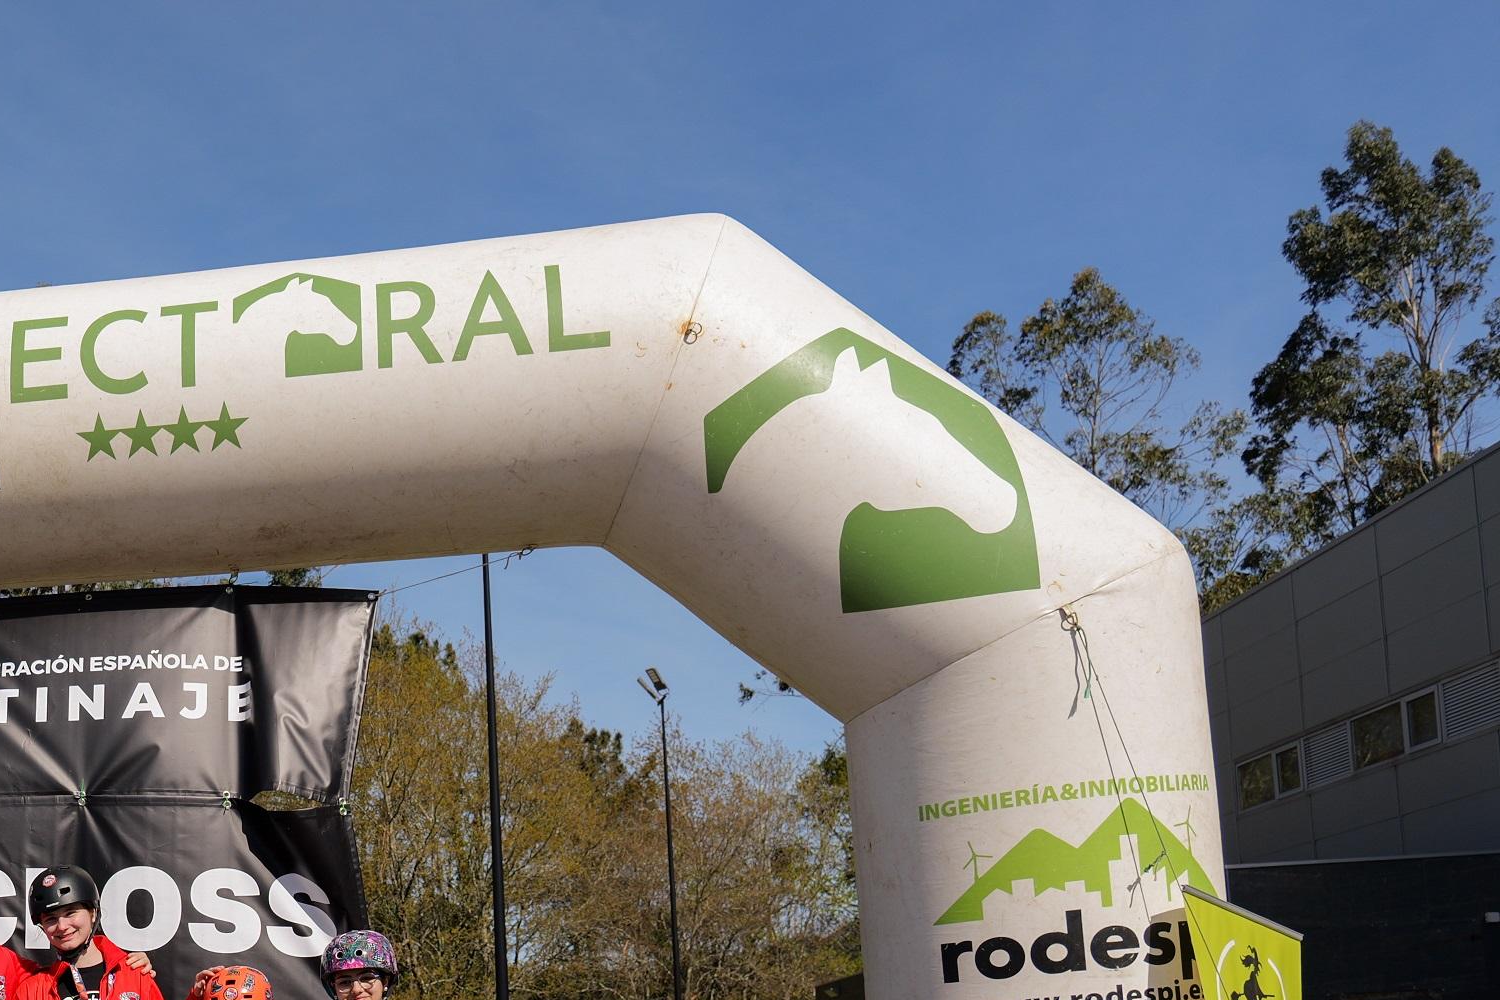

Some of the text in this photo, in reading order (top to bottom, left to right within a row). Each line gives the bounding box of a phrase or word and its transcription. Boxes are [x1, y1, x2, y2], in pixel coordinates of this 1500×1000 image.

[89, 650, 207, 673] ESPAÑOLA
[213, 655, 243, 673] DE
[940, 909, 1197, 984] rodes
